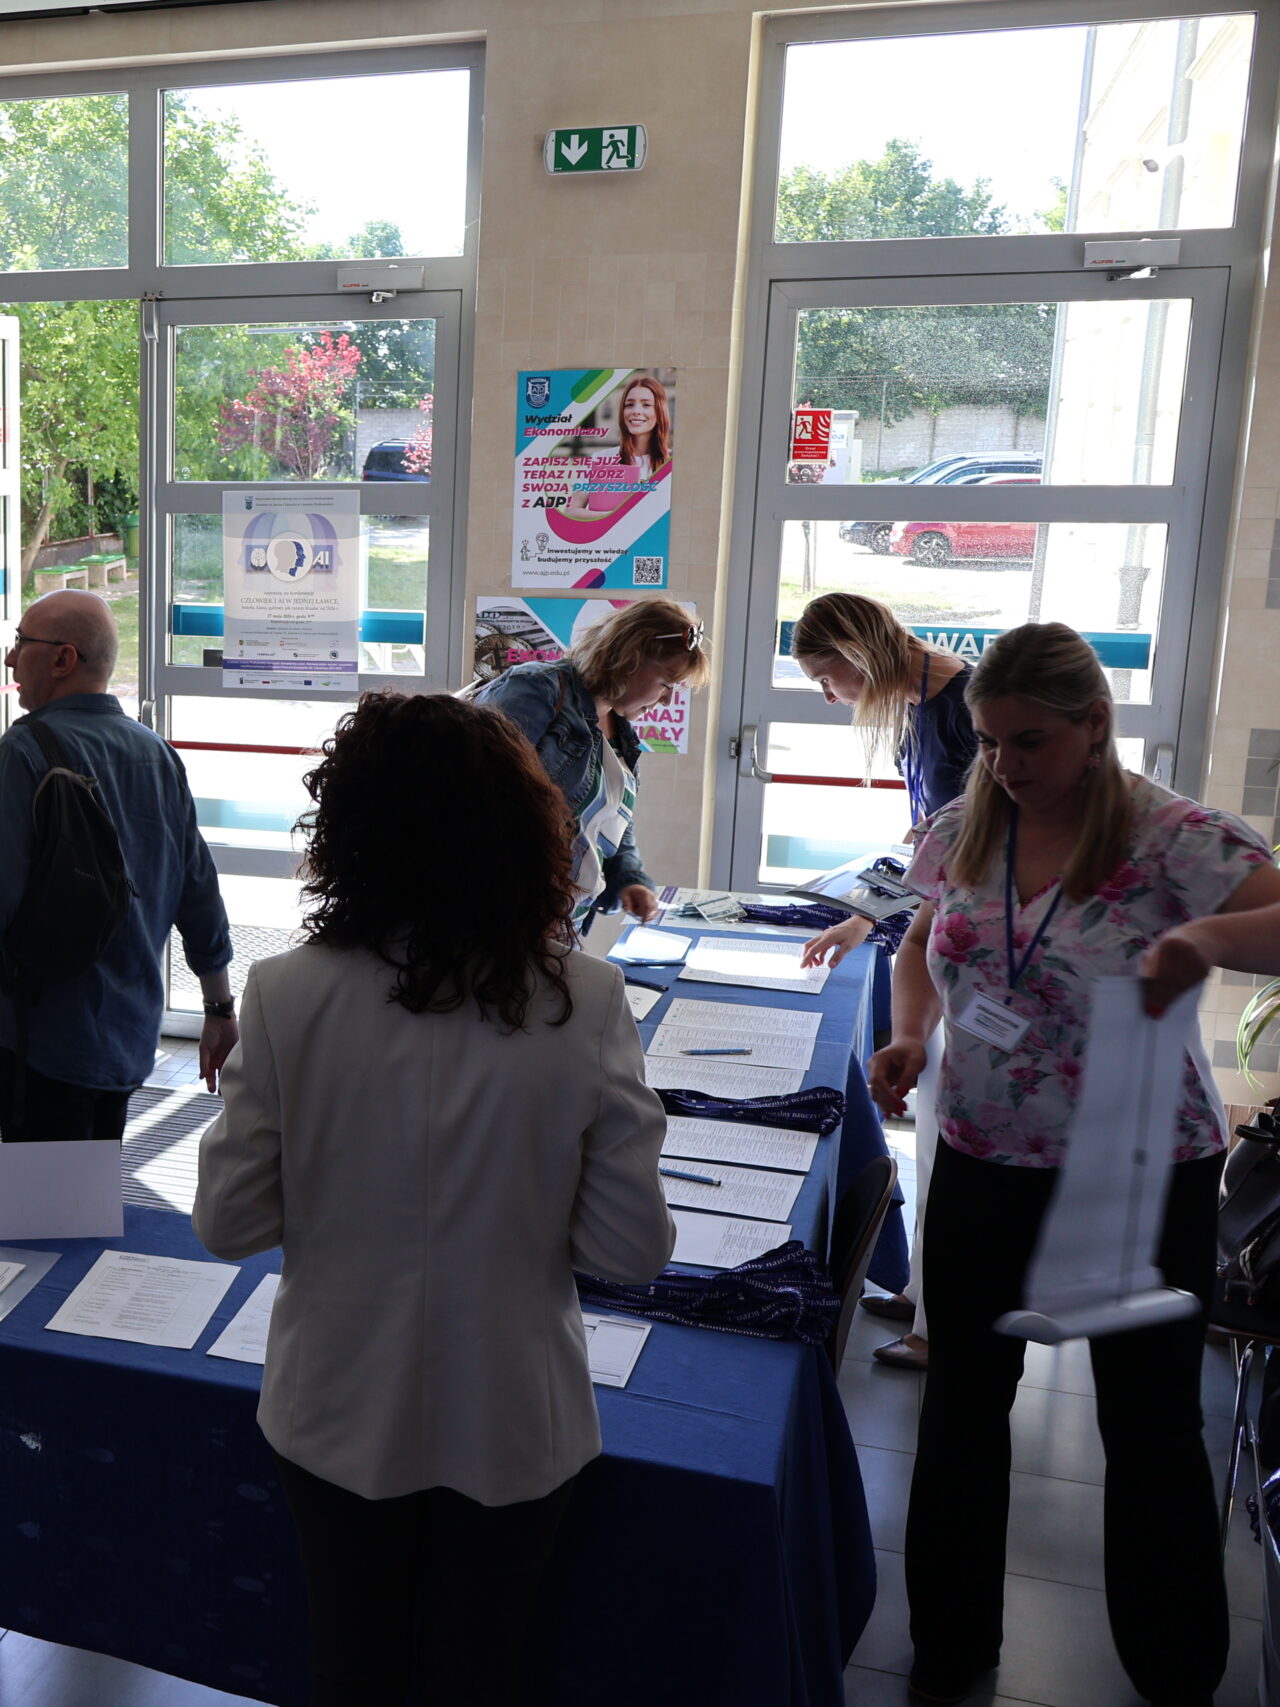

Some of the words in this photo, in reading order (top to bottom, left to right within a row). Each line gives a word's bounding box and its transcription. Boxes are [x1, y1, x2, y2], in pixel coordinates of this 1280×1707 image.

[524, 413, 573, 425] Wydział
[523, 425, 610, 438] Ekonomiczny
[522, 457, 570, 467] ZAPISZ
[571, 456, 593, 469] SIĘ
[593, 453, 622, 467] JUŻ
[522, 470, 564, 480] TERAZ
[576, 467, 625, 479] TWÓRZ
[521, 483, 569, 495] SWOJĄ
[572, 479, 658, 492] PRZYSZŁOŚĆ
[532, 496, 573, 509] AJP!
[507, 647, 564, 662] EKON
[636, 708, 685, 723] NAJ
[632, 725, 684, 741] IAŁY
